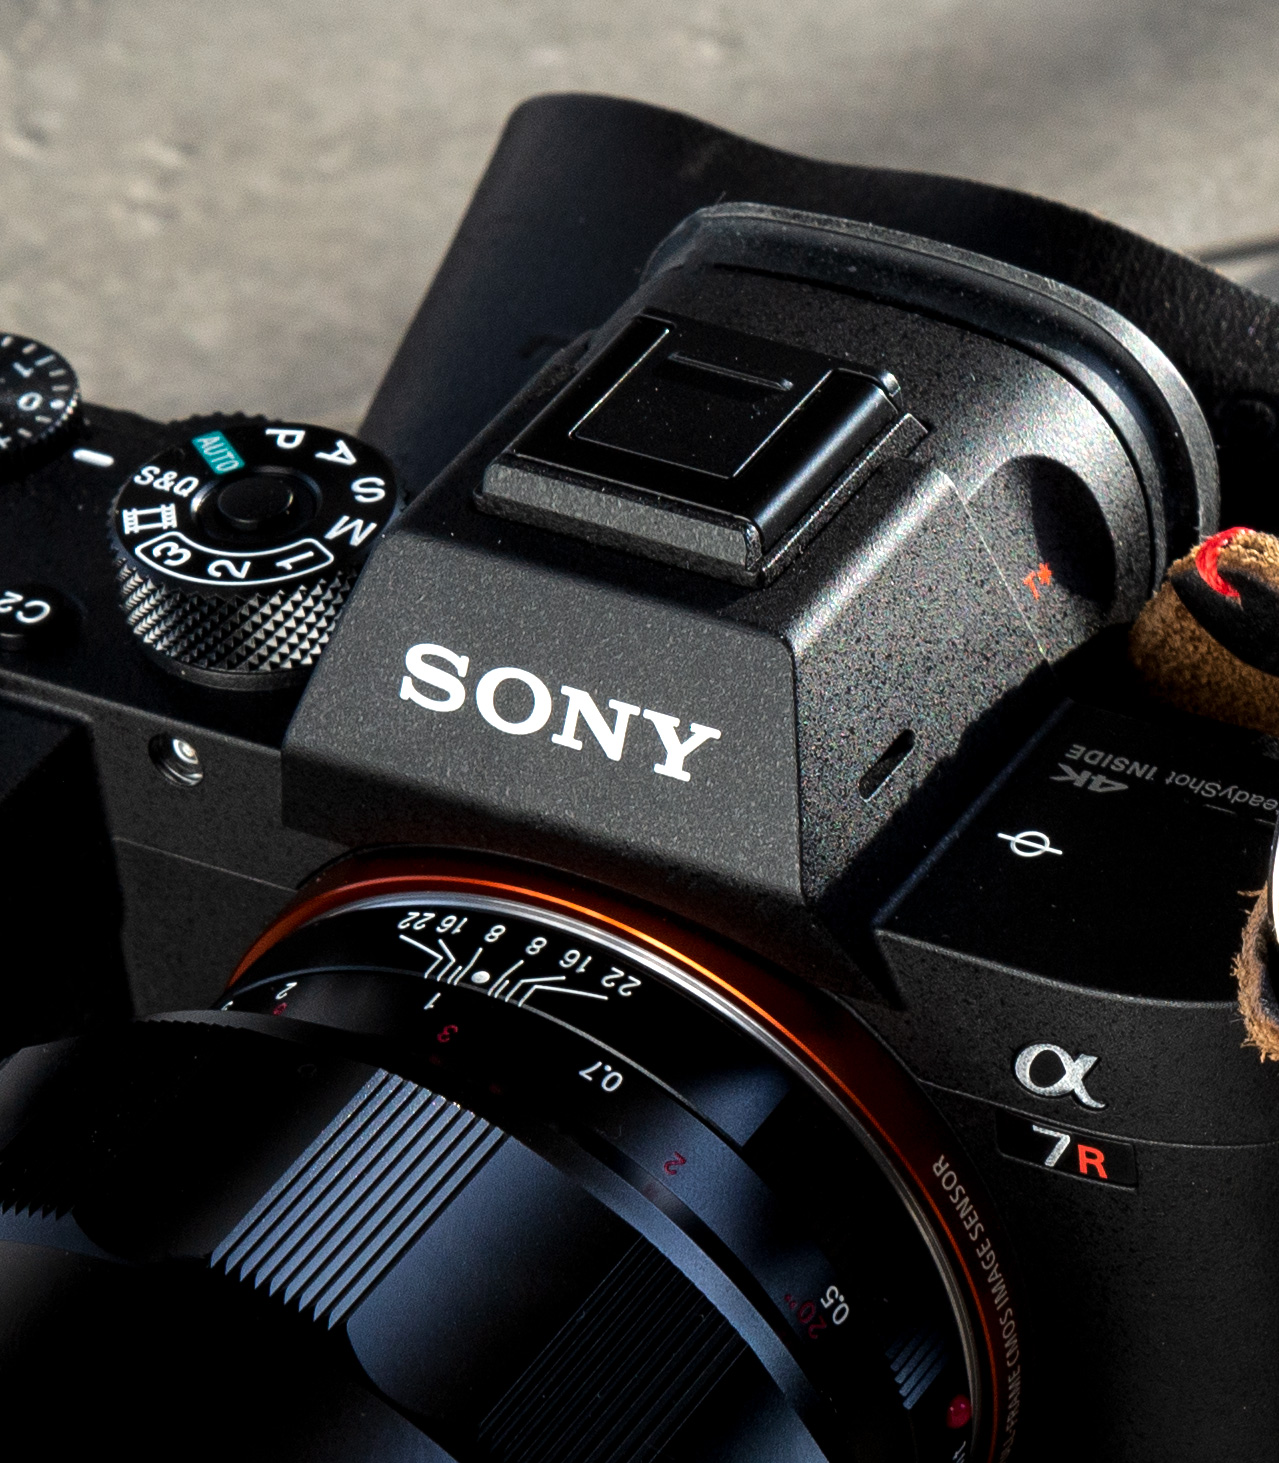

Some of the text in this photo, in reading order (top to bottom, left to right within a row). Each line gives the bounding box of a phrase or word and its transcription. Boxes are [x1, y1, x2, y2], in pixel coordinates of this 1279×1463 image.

[17, 392, 43, 411] 0
[197, 436, 239, 473] AUTO
[265, 428, 306, 449] P
[315, 440, 357, 465] A
[133, 465, 200, 498] S&Q
[351, 477, 386, 503] S
[324, 515, 377, 547] M
[152, 541, 314, 579] 1 2 3
[399, 642, 721, 783] SONY
[1049, 763, 1130, 793] 4K
[1165, 771, 1279, 813] eadyShot
[398, 911, 643, 996] 22 16 8 8 16 22
[579, 1061, 624, 1092] 0.7
[663, 1151, 687, 1175] 2
[1031, 1125, 1109, 1180] 7R
[932, 1154, 984, 1242] SENSOR
[976, 1238, 1009, 1310] IMAGE
[821, 1286, 849, 1325] 0.5
[999, 1307, 1021, 1368] CMOS
